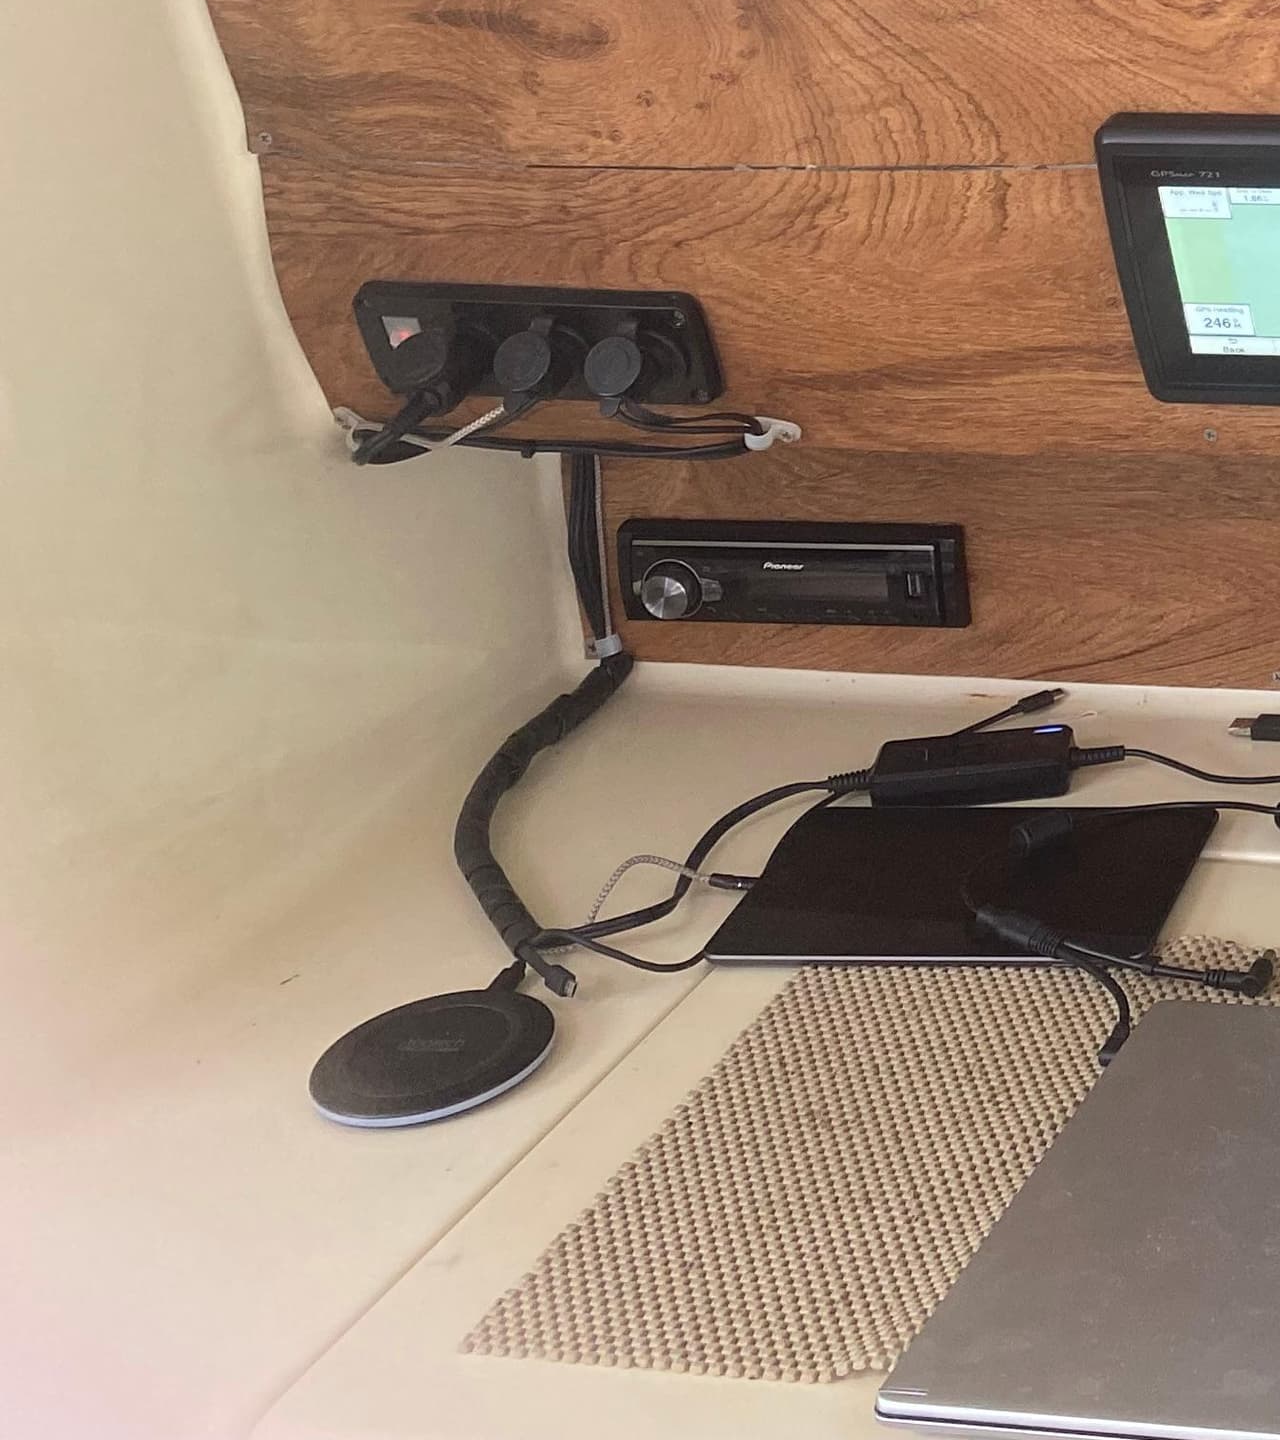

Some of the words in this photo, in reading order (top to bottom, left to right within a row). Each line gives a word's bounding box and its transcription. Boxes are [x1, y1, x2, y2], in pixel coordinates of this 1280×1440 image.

[1198, 170, 1221, 179] 721
[1204, 317, 1231, 329] 246
[763, 561, 804, 571] Pioneer
